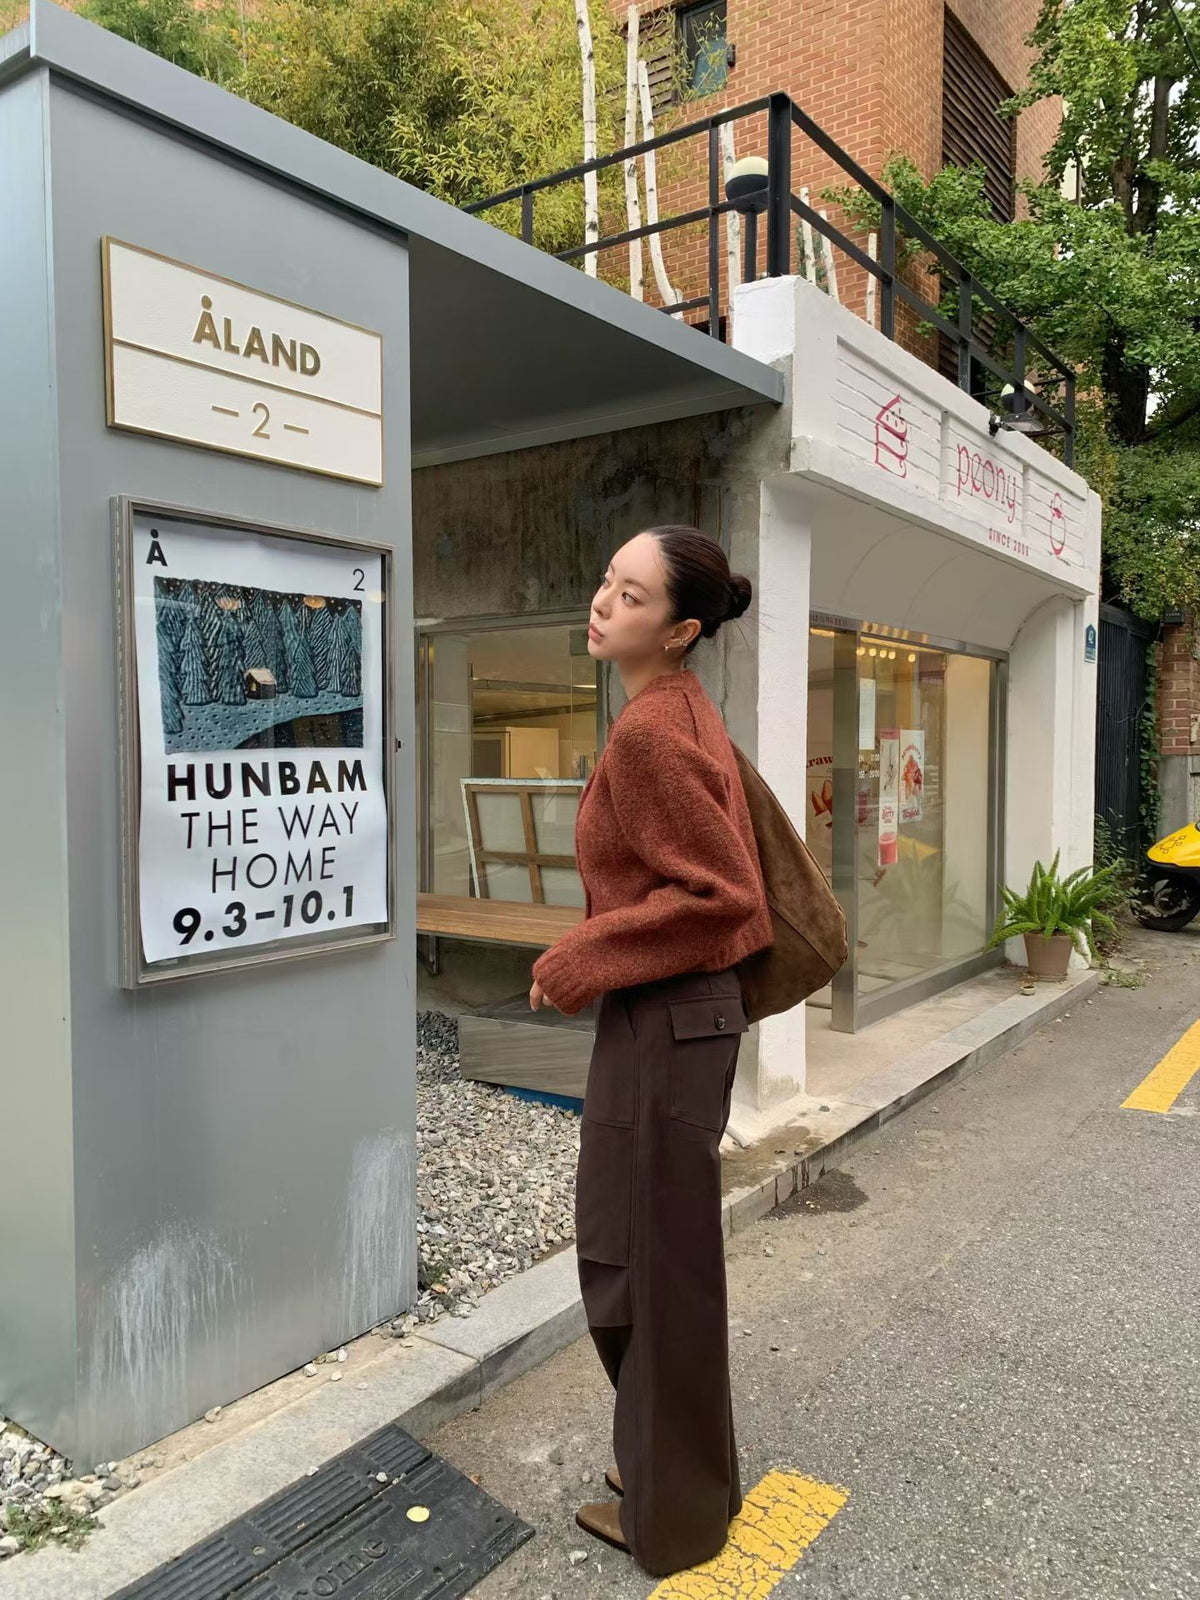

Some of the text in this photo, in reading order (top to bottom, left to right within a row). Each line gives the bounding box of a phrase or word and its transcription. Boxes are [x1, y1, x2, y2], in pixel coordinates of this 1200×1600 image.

[192, 294, 321, 376] ÅLAND
[956, 442, 1016, 523] peony
[146, 528, 169, 567] Å
[988, 527, 1011, 548] SINCE
[352, 568, 366, 592] 2
[167, 759, 368, 802] HUNBAM
[180, 801, 360, 849] THE WAY
[211, 846, 337, 894] HOME
[172, 885, 354, 946] 9.3-10.1
